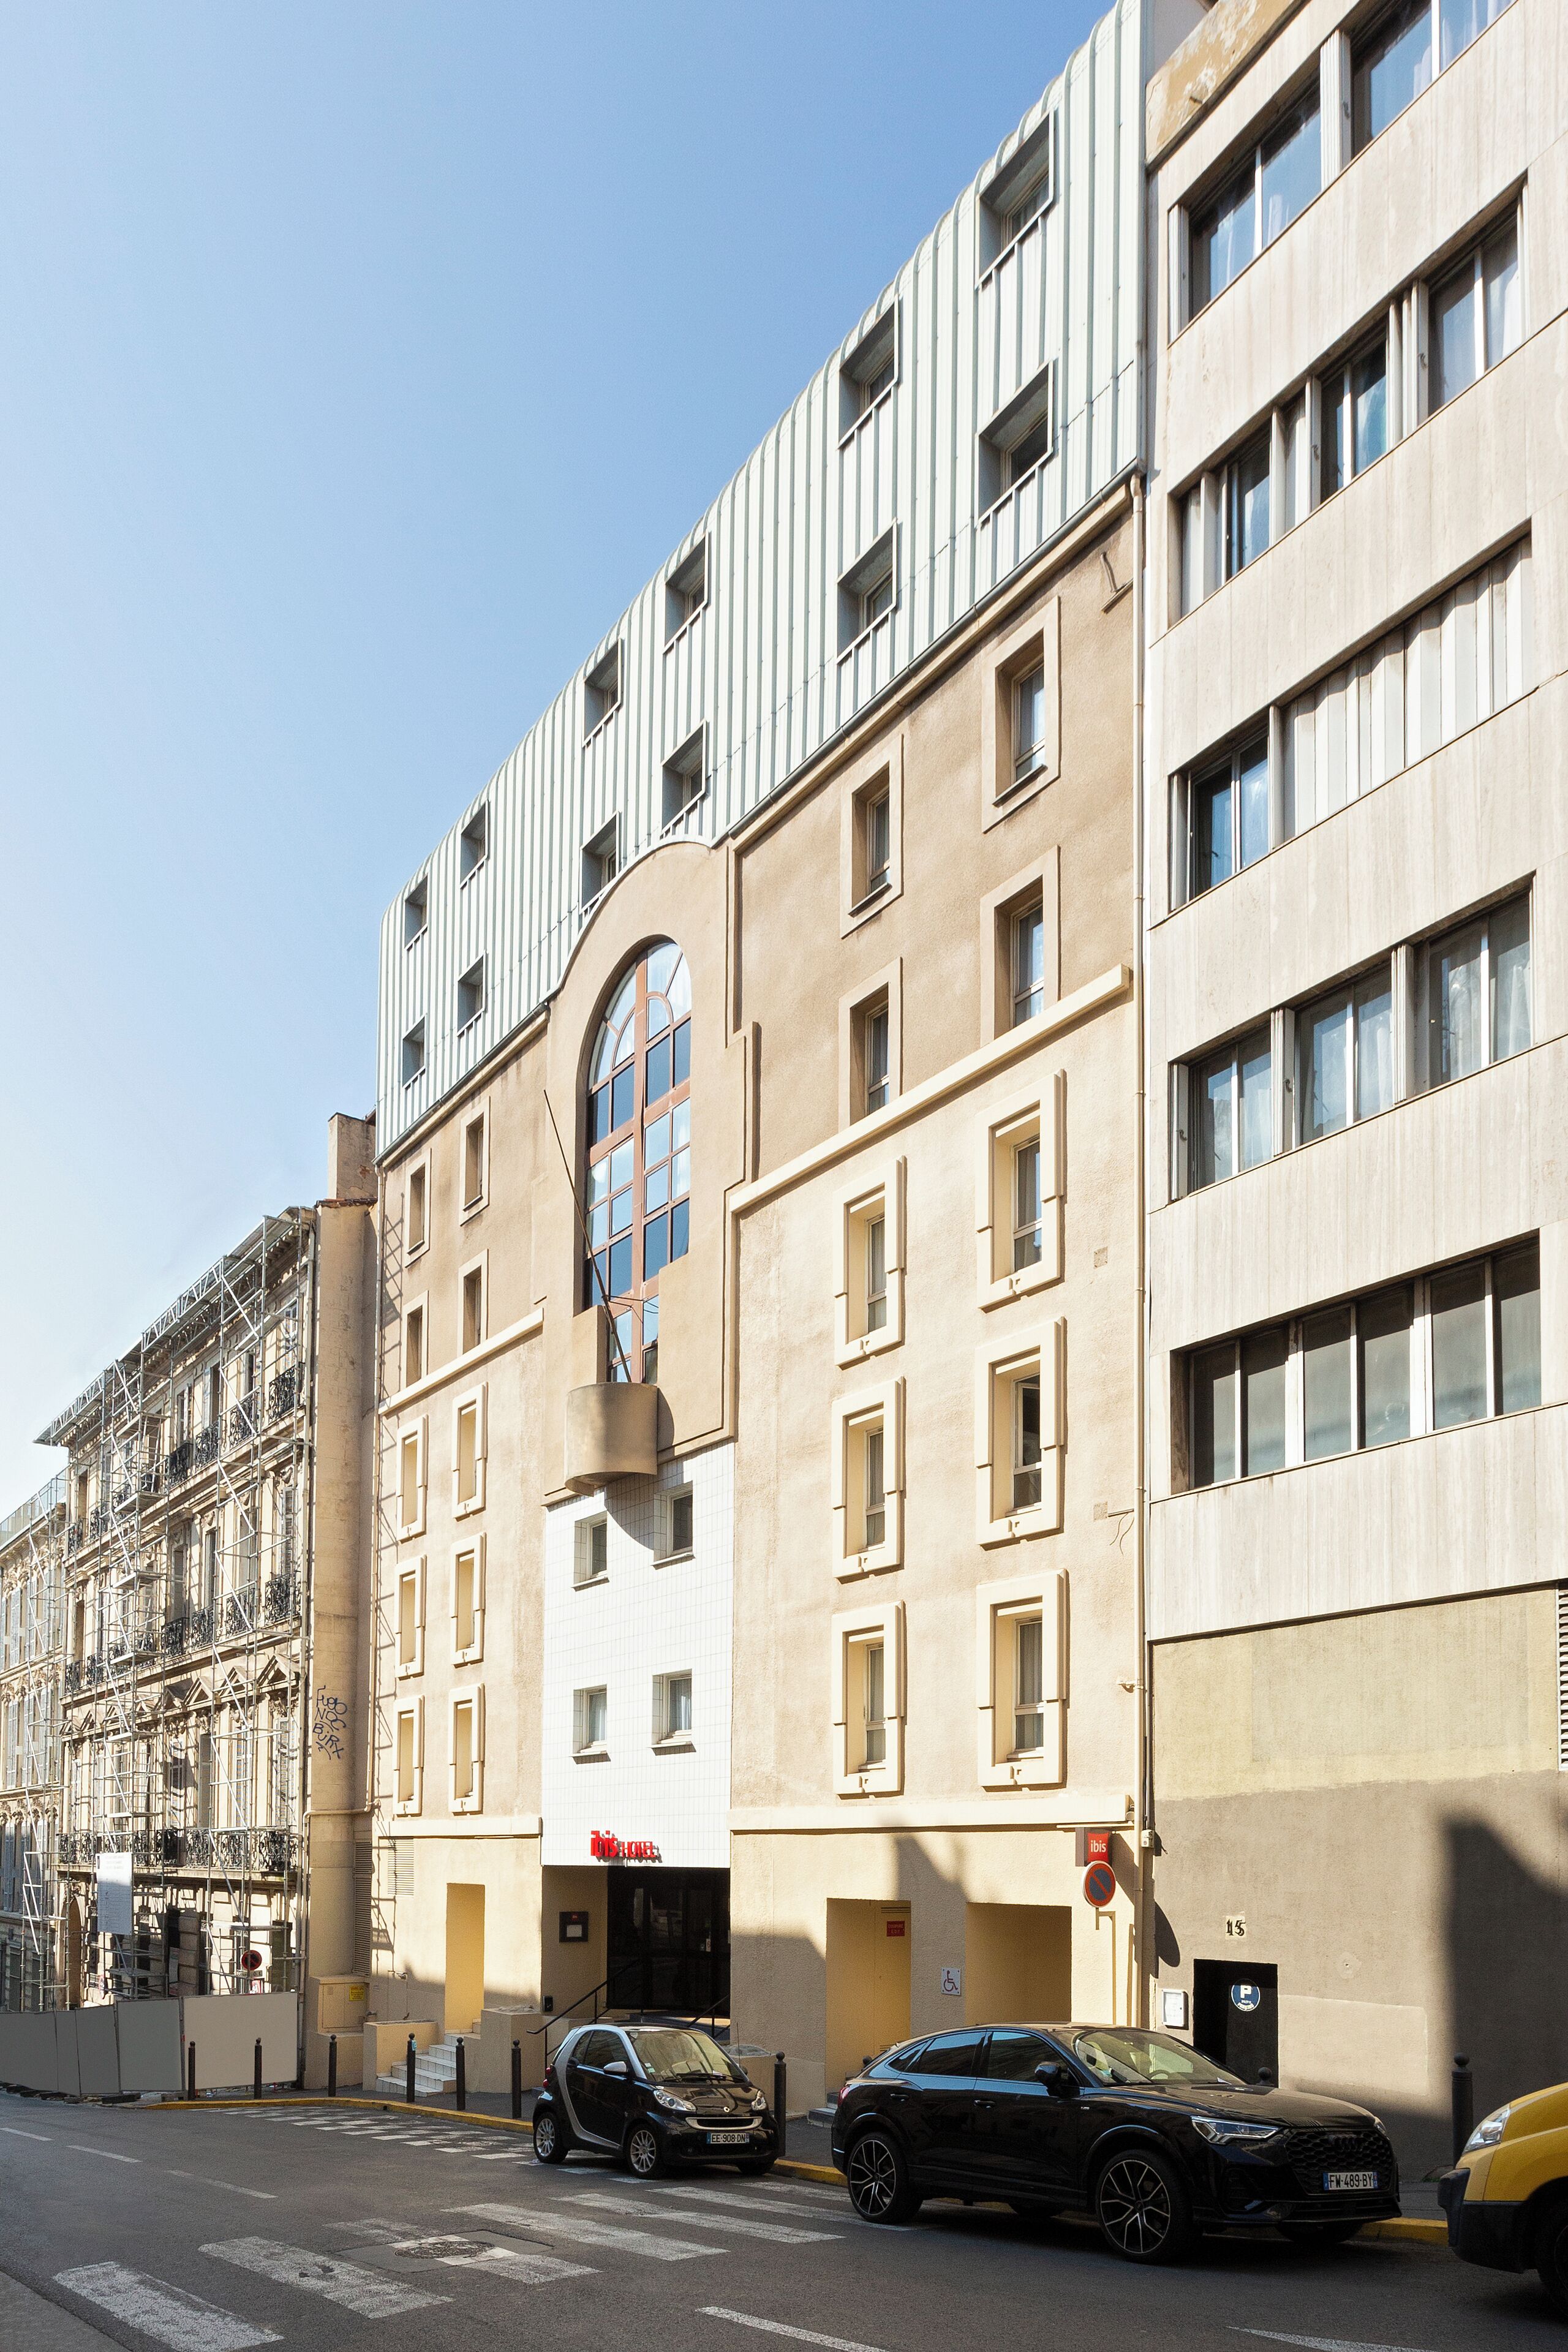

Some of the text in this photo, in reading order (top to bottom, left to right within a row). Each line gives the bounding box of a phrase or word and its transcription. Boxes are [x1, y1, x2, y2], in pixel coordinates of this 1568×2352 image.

[590, 1830, 656, 1858] ibis HOTEL
[1090, 1839, 1107, 1853] ibis
[1226, 1919, 1246, 1936] 15
[1240, 1985, 1252, 1999] P
[1328, 2173, 1373, 2188] FW-489-BY
